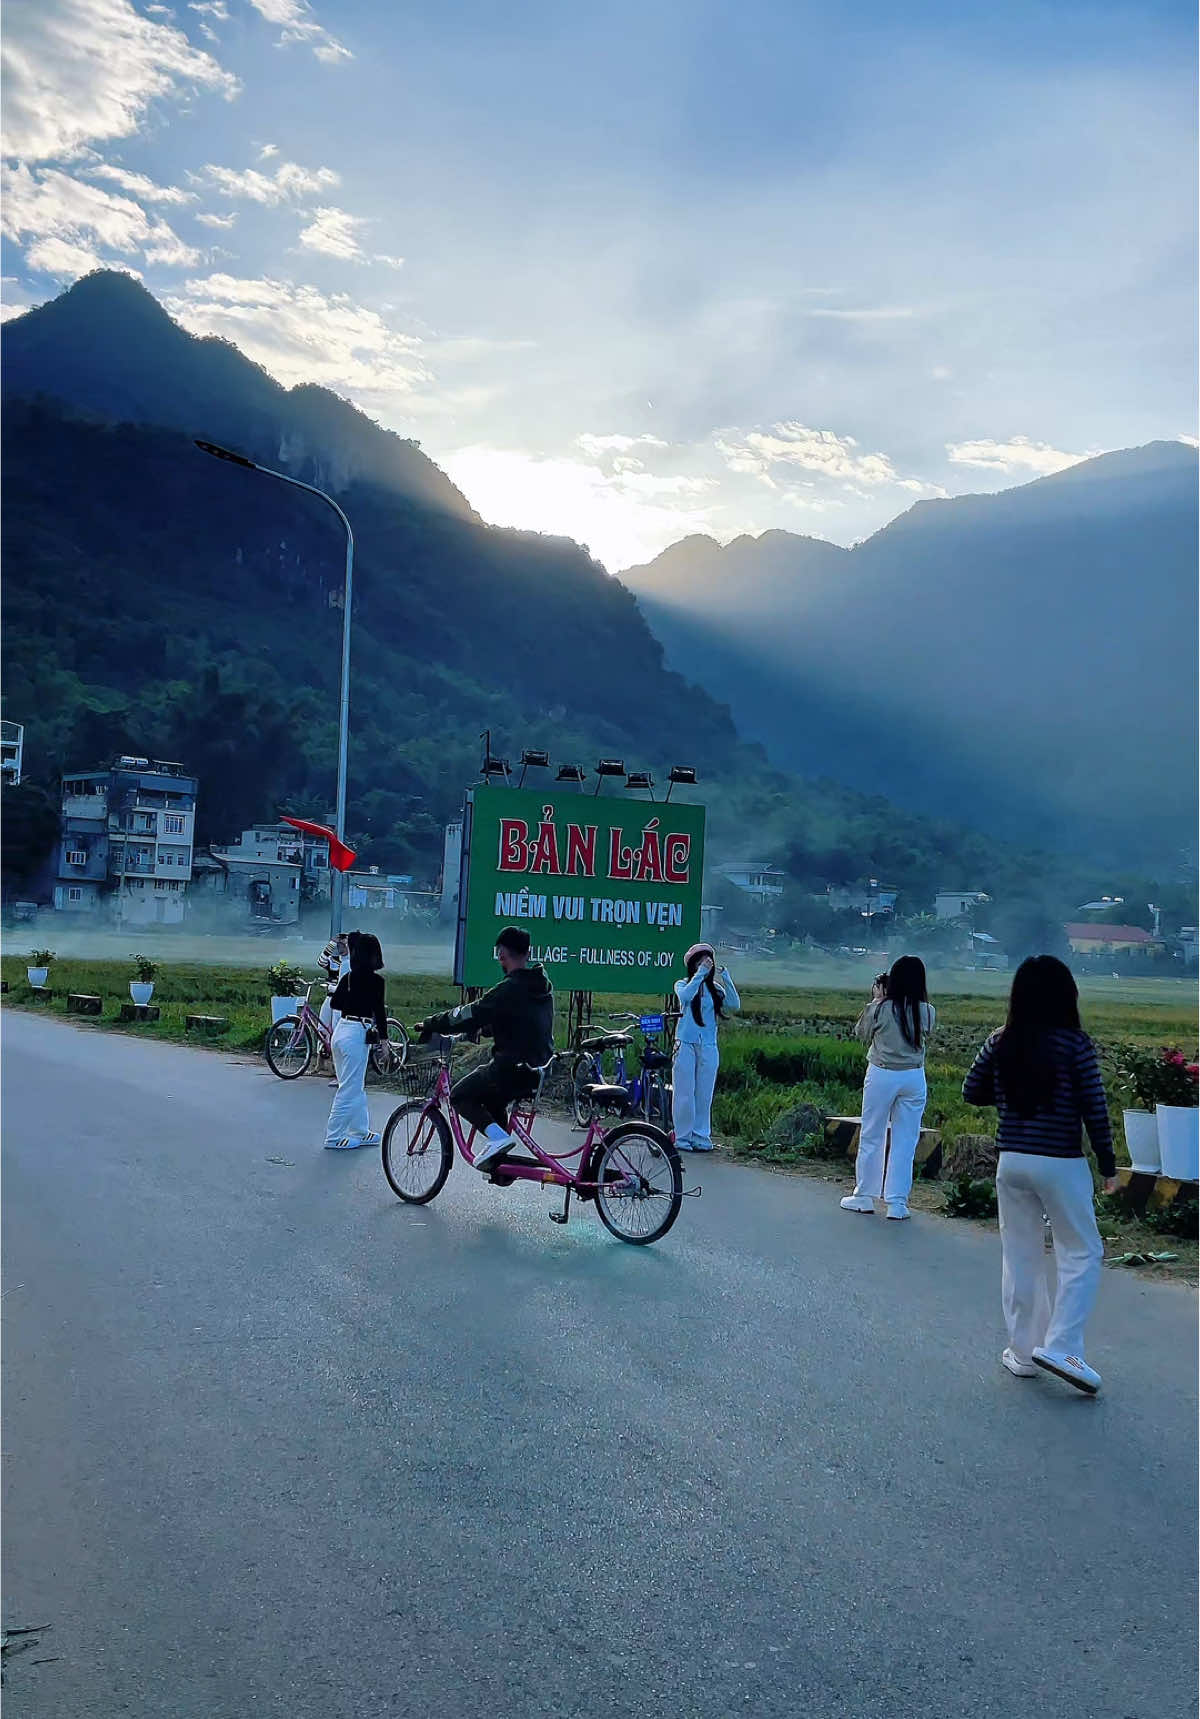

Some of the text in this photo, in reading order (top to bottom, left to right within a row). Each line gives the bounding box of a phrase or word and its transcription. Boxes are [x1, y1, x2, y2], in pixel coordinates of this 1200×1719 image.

[496, 804, 691, 883] BẢN LÁC
[495, 886, 683, 931] NIỀM VUI TRỌN VẸN
[580, 947, 635, 966] FULLNESS
[637, 950, 652, 966] OF
[653, 951, 675, 967] JOY
